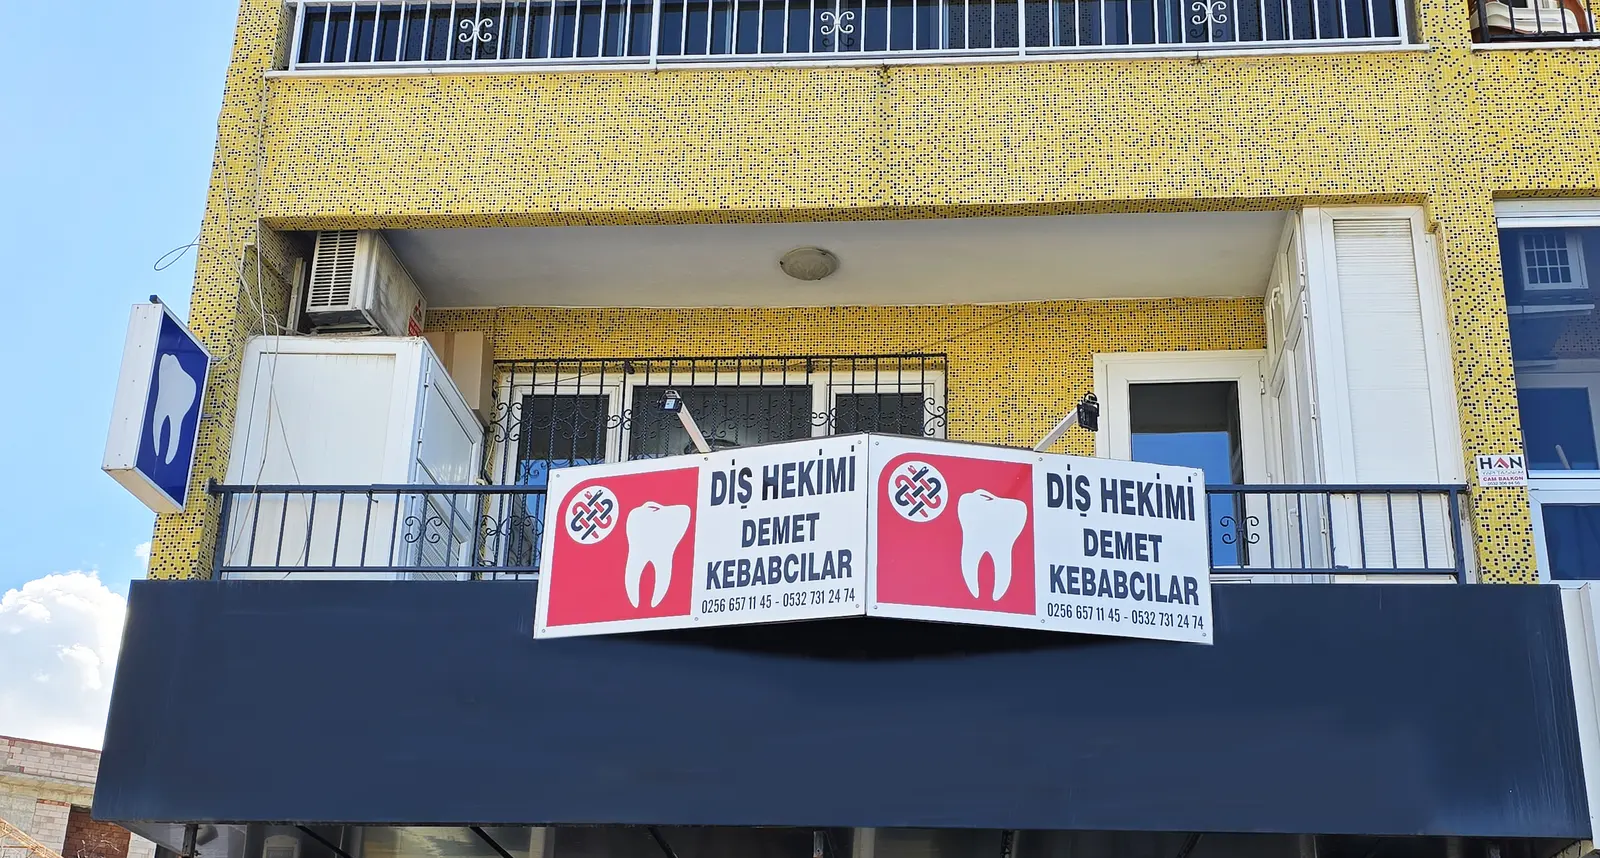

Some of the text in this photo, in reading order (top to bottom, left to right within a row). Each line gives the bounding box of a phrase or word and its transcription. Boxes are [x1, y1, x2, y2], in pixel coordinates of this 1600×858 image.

[710, 445, 856, 509] DİŞ HEKİMİ
[1046, 464, 1196, 521] DİŞ HEKİMİ
[741, 512, 820, 548] DEMET
[1083, 528, 1162, 563] DEMET
[706, 549, 852, 590] KEBABCILAR
[1049, 564, 1199, 606] KEBABCILAR
[701, 599, 726, 614] 0256
[728, 596, 747, 612] 657
[749, 595, 757, 610] 11
[759, 594, 772, 609] 45
[783, 591, 807, 607] 0532
[810, 590, 825, 605] 731
[828, 589, 841, 604] 24
[844, 587, 856, 602] 74
[1047, 602, 1073, 618] 0256
[1076, 605, 1094, 620] 657
[1096, 606, 1105, 621] 11
[1108, 608, 1121, 622] 45
[1131, 609, 1156, 626] 0532
[1158, 612, 1174, 627] 731
[1177, 613, 1190, 629] 24
[1192, 615, 1204, 630] 74
